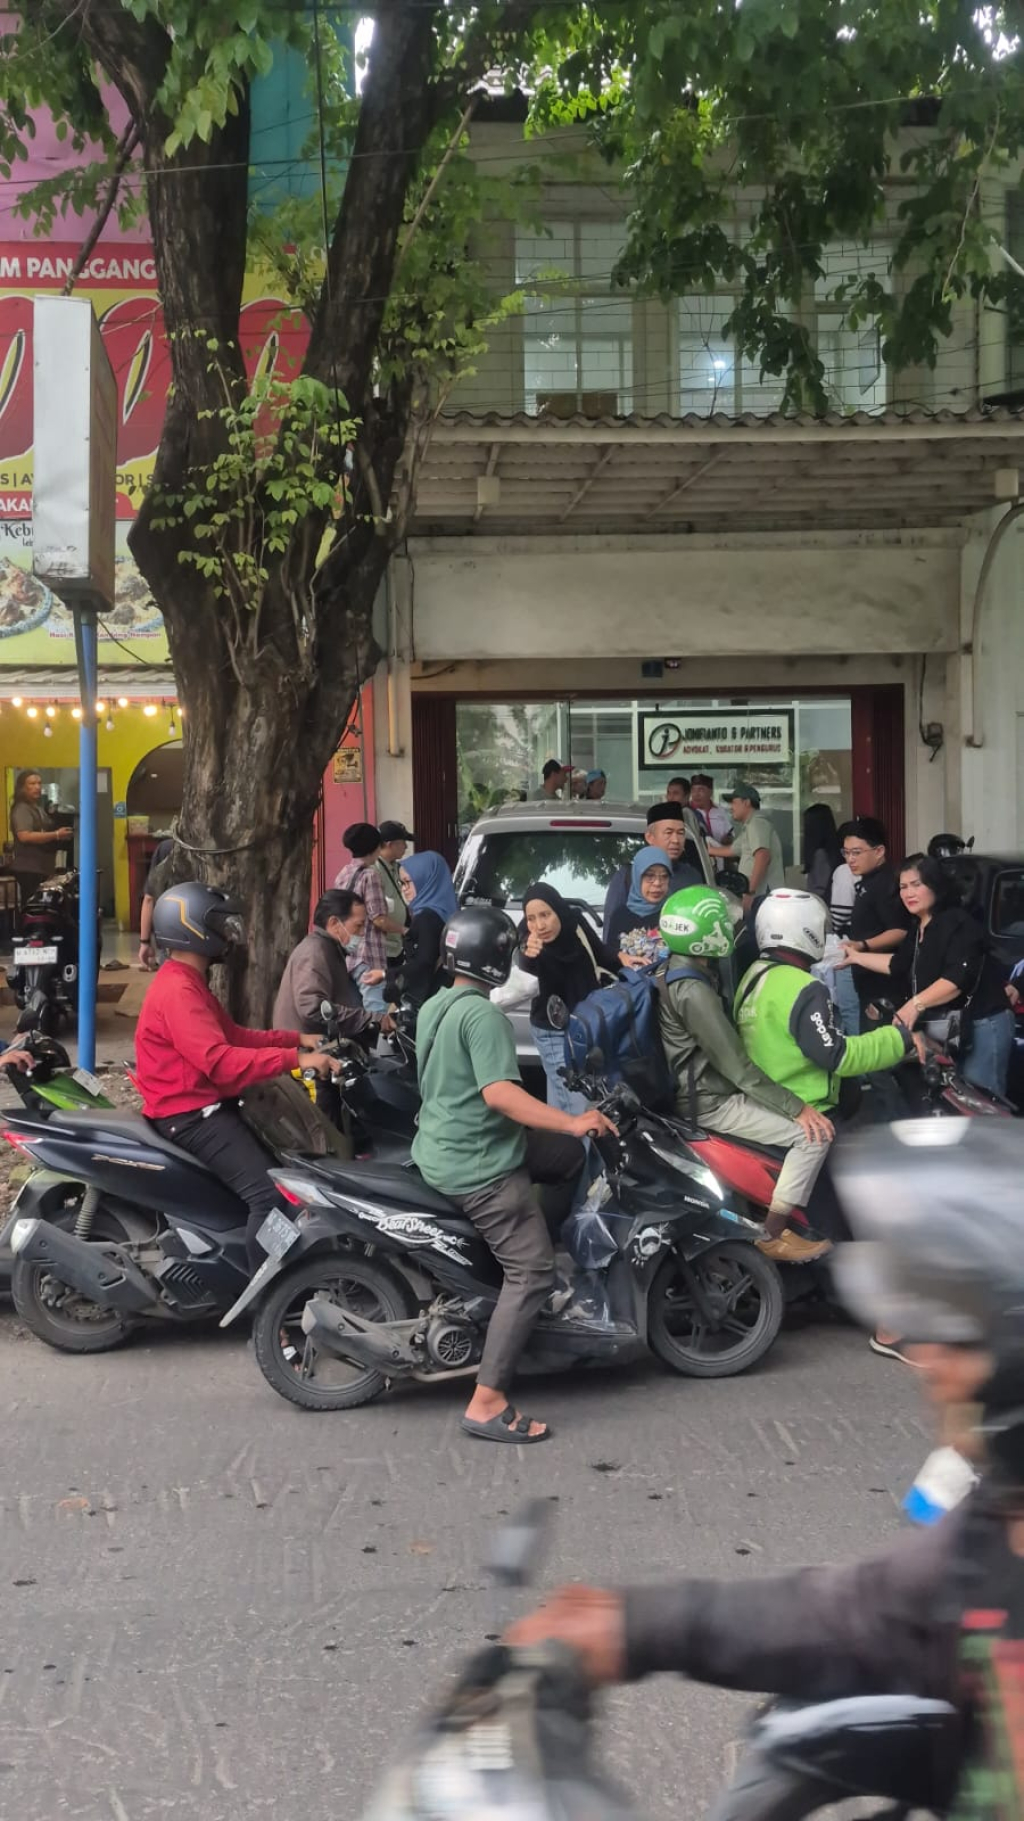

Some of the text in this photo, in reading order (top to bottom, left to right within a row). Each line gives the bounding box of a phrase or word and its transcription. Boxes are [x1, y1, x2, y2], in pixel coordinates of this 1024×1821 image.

[21, 473, 33, 485] A
[741, 726, 782, 740] PARTNERS
[810, 1011, 835, 1048] gopay
